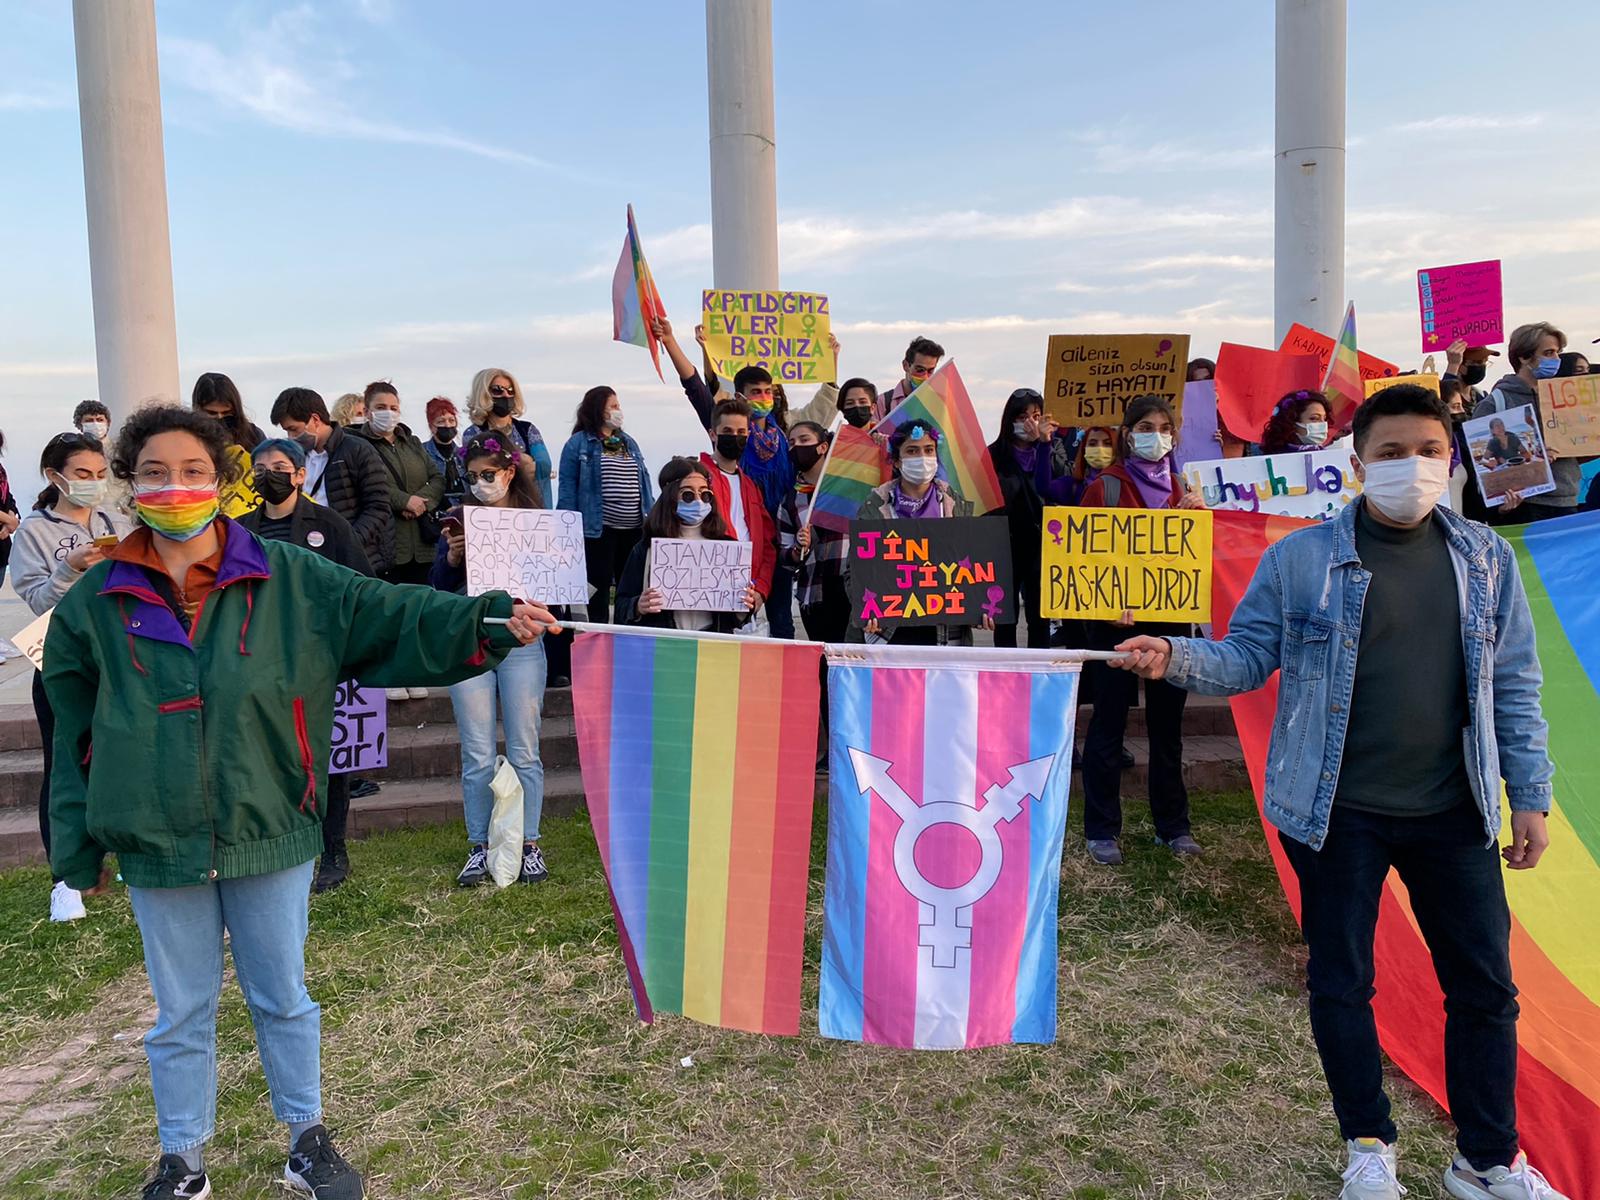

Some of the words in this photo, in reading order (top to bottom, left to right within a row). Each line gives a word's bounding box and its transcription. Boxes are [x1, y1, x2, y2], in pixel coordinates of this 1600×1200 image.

[702, 291, 829, 315] KAPATILDIĞIMIZ
[710, 313, 785, 336] EVLERİ
[731, 336, 824, 360] BAŞINIZA
[1061, 346, 1120, 363] aileniz
[1292, 335, 1329, 359] KADIN
[1089, 362, 1124, 376] sizin
[1130, 354, 1176, 373] olsun!
[1057, 379, 1087, 397] Biz
[1096, 374, 1167, 393] HAYATI
[1077, 392, 1176, 418] İSTİYZ
[470, 507, 553, 532] GECE
[467, 532, 584, 554] KARANLIKTAN
[857, 530, 929, 561] JÎN
[1067, 514, 1197, 559] MEMELER
[467, 553, 584, 570] KORKARSAN
[654, 540, 752, 567] İSTANBUL
[470, 569, 495, 586] BU
[507, 569, 557, 586] KENTİ
